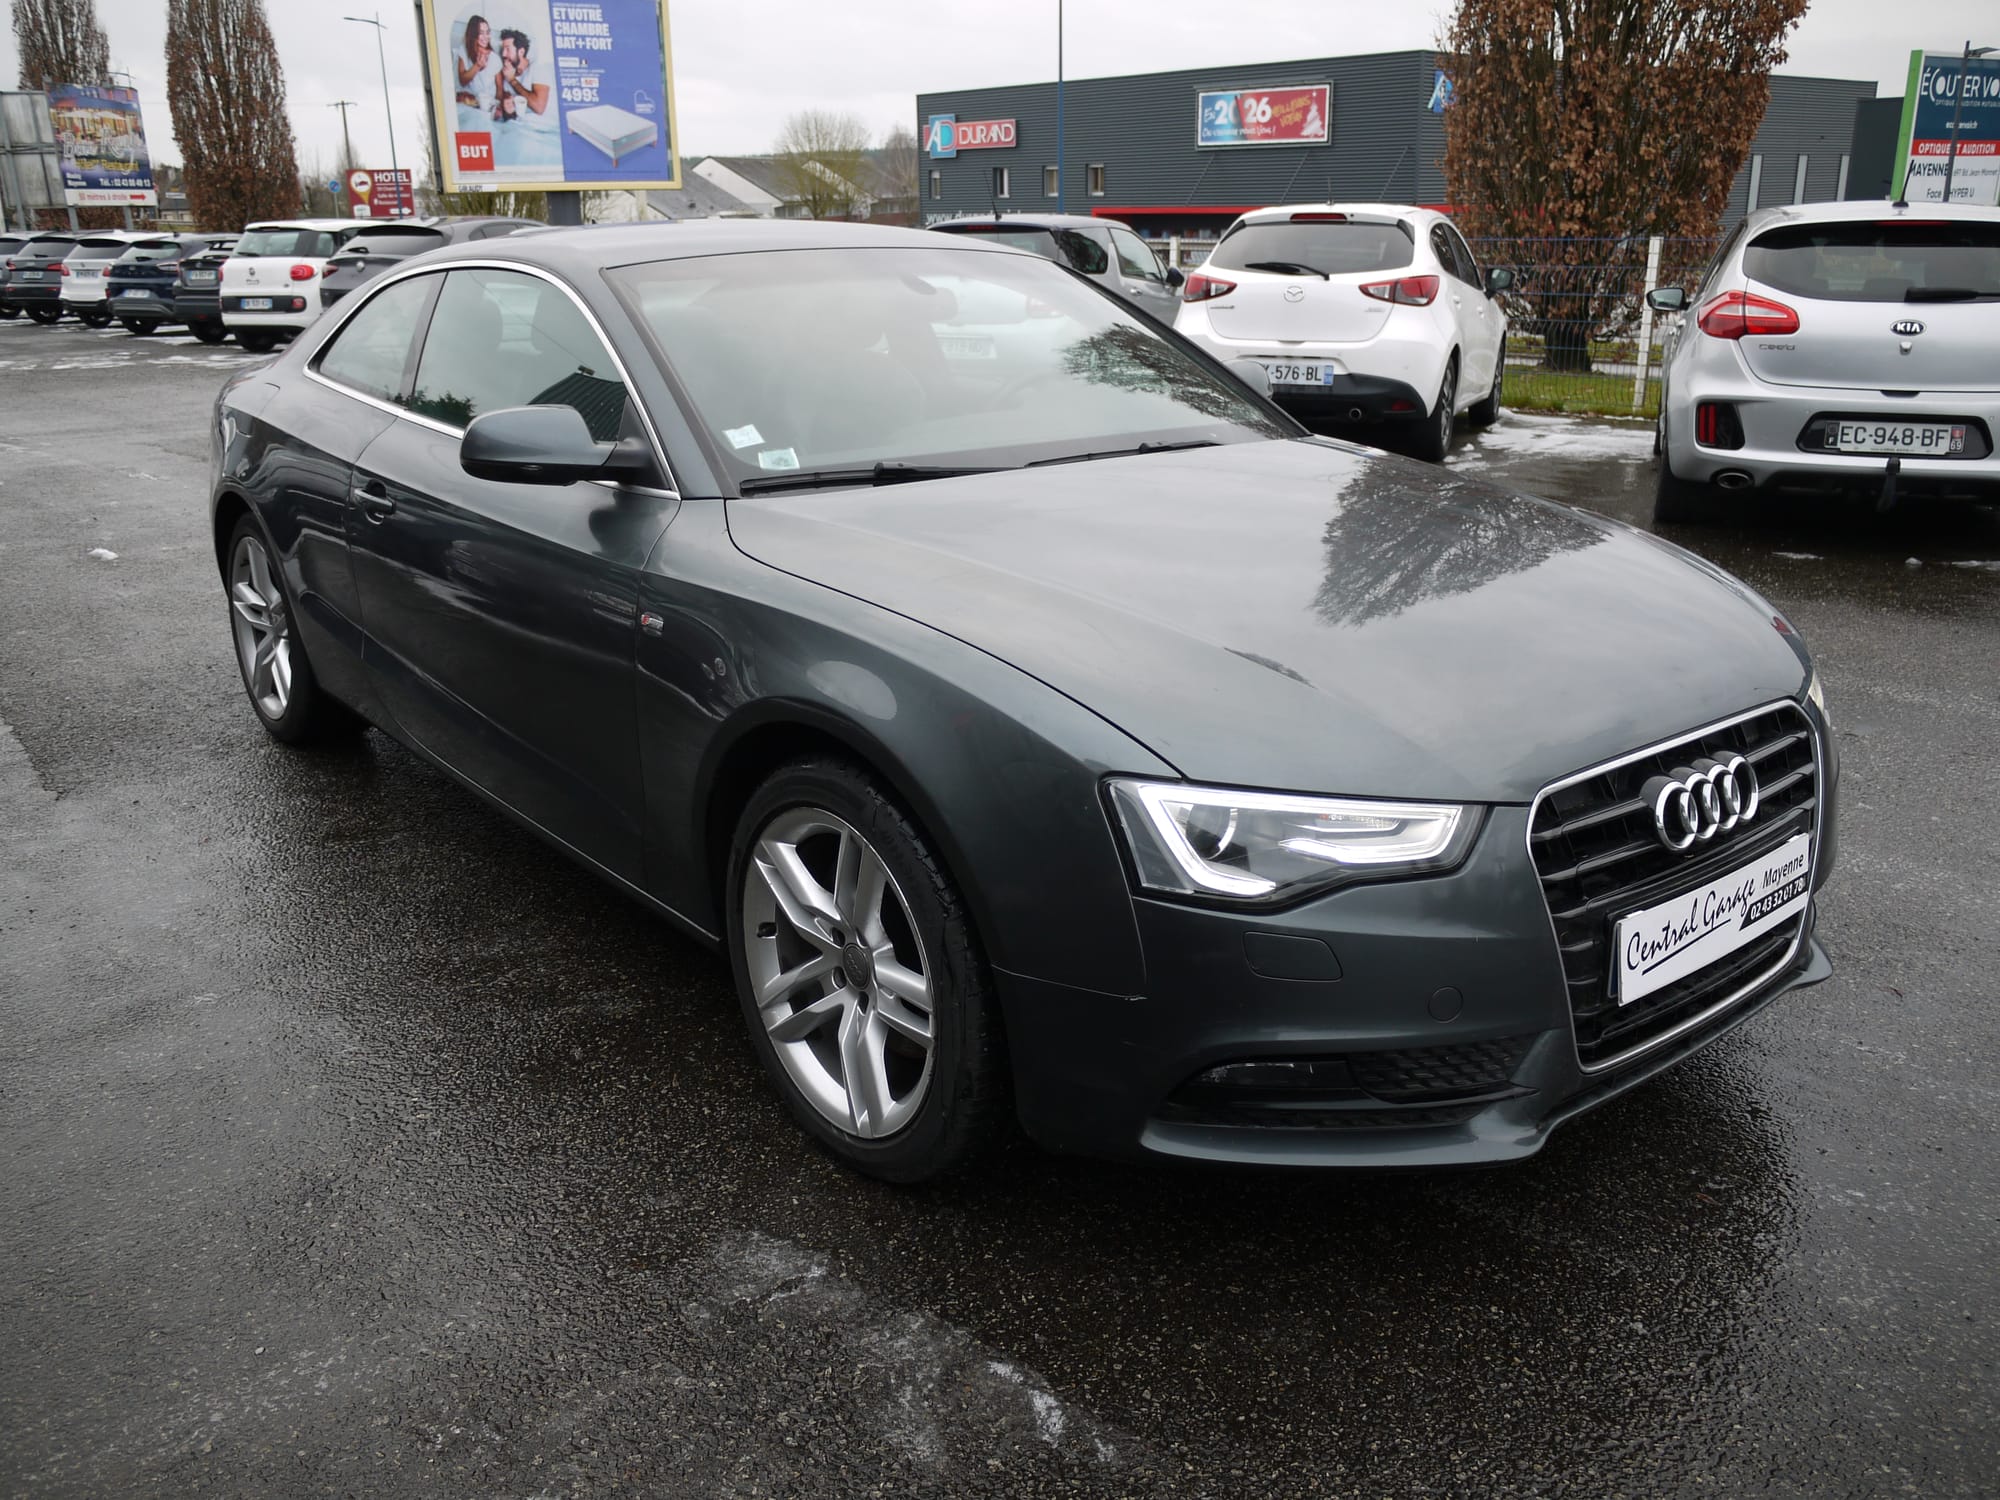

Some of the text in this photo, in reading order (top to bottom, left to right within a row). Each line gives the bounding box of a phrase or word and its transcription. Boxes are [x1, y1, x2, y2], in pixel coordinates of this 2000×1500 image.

[553, 7, 603, 21] ET VOTRE
[555, 22, 610, 36] CHAMBRE
[1921, 67, 2000, 102] ÉCOUER VO
[959, 123, 1014, 145] DURAND
[461, 145, 488, 158] BUT
[1918, 143, 1951, 154] OPTIQUE
[1962, 144, 1996, 154] AUDITION
[1927, 188, 1942, 198] Face
[1897, 322, 1920, 332] KIA
[1840, 426, 1948, 447] EC-948-BF
[1950, 440, 1962, 450] 69
[1627, 854, 1804, 970] Central Garage Mayenne
